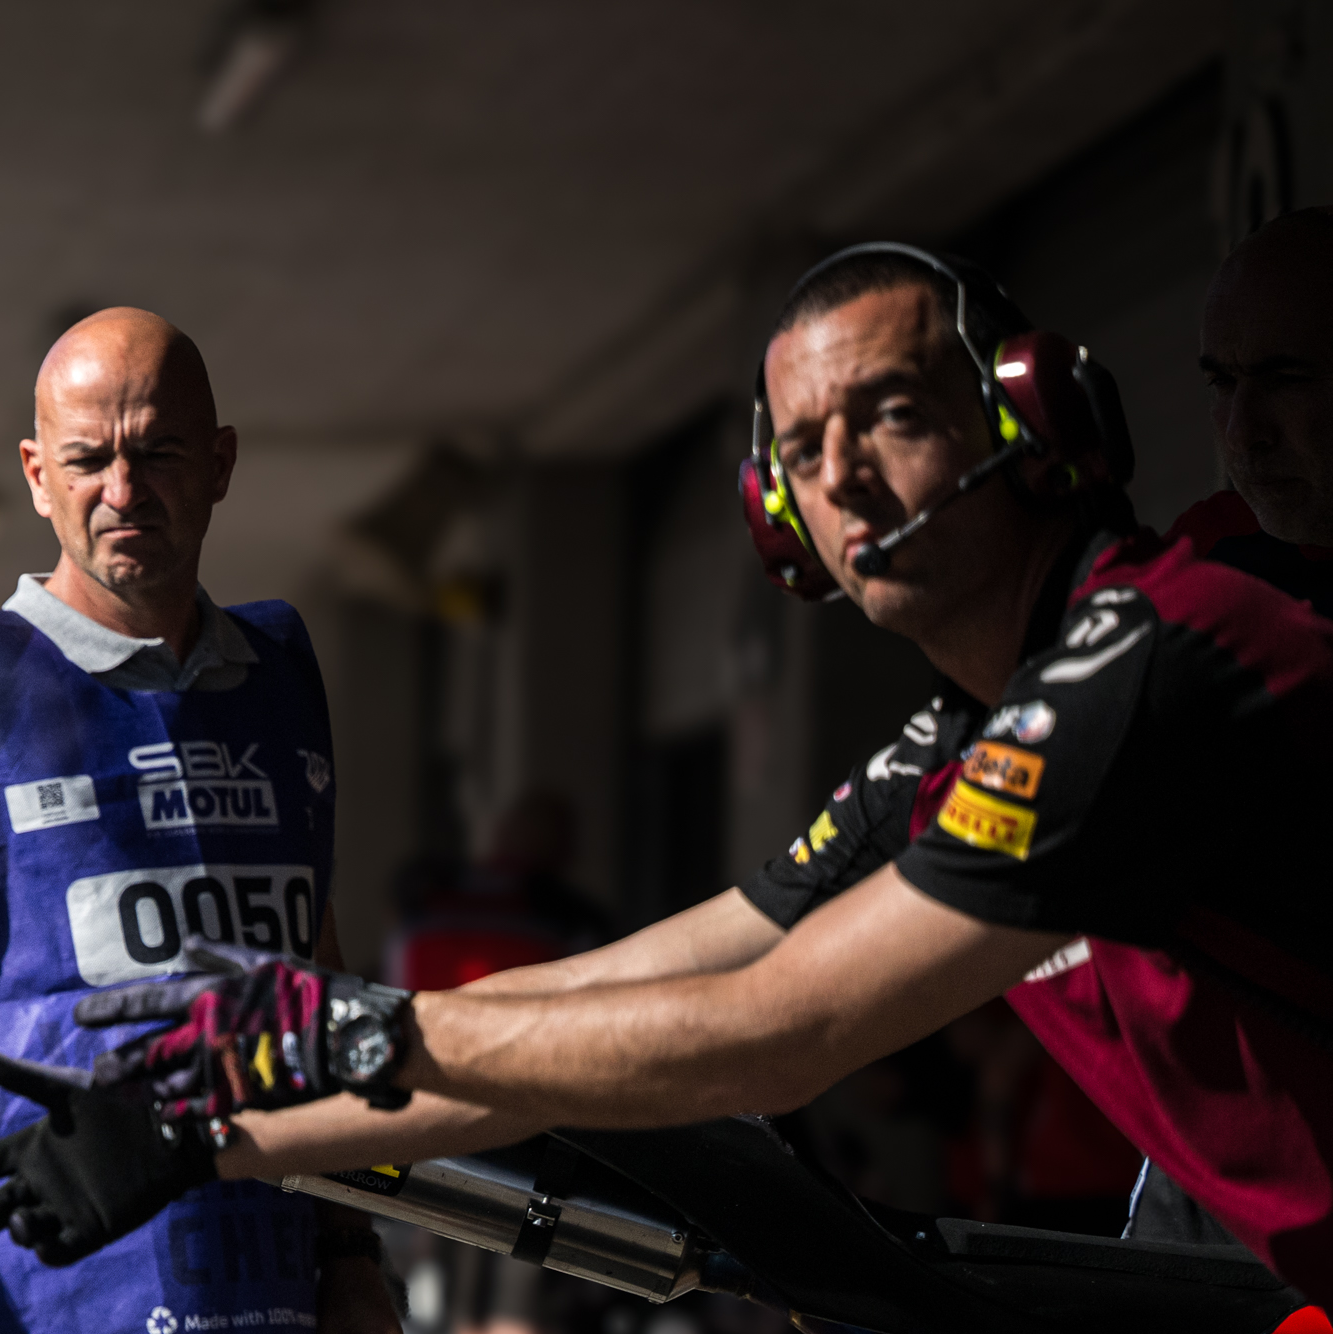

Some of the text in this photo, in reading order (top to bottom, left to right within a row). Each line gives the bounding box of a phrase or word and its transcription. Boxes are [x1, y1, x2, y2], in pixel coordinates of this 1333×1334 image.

[128, 740, 267, 782] SBK
[150, 786, 271, 823] MOTUL
[118, 874, 315, 964] 0050
[184, 1313, 229, 1332] Made
[231, 1309, 265, 1327] with
